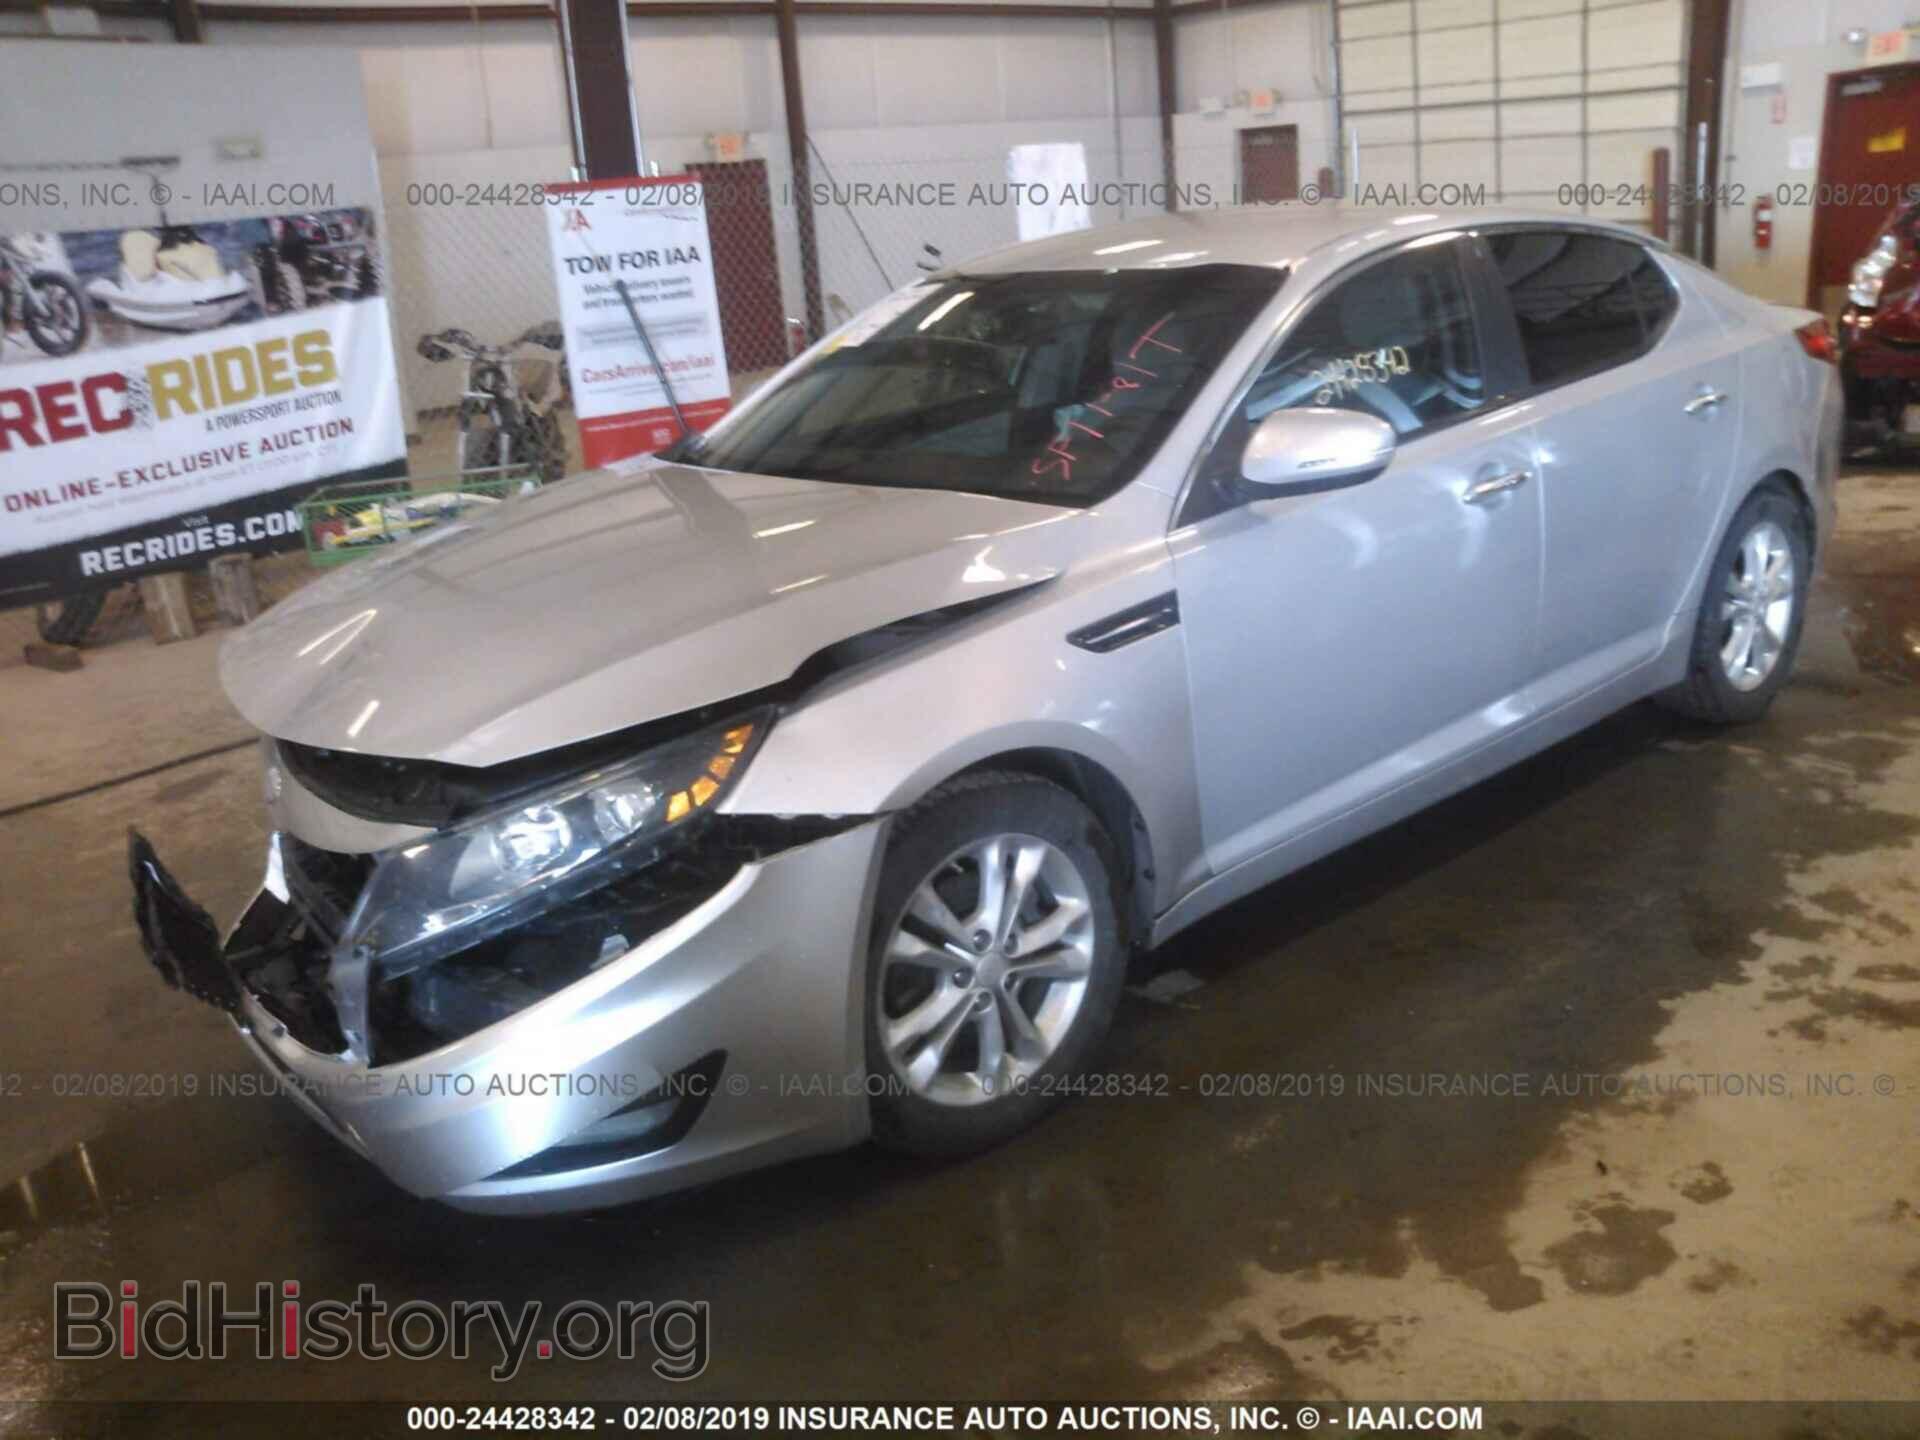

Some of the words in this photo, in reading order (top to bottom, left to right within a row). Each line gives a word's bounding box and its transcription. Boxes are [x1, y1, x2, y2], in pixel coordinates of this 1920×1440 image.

[563, 256, 612, 276] TOW
[618, 250, 661, 271] FOR
[665, 245, 701, 266] IAA
[0, 371, 135, 452] REC
[145, 328, 337, 422] RIDES
[216, 400, 292, 430] POWERSPORT
[295, 389, 343, 412] AUCTION
[3, 441, 252, 514] ONLINE-EXCLUSIVE
[259, 415, 355, 456] AUCTION
